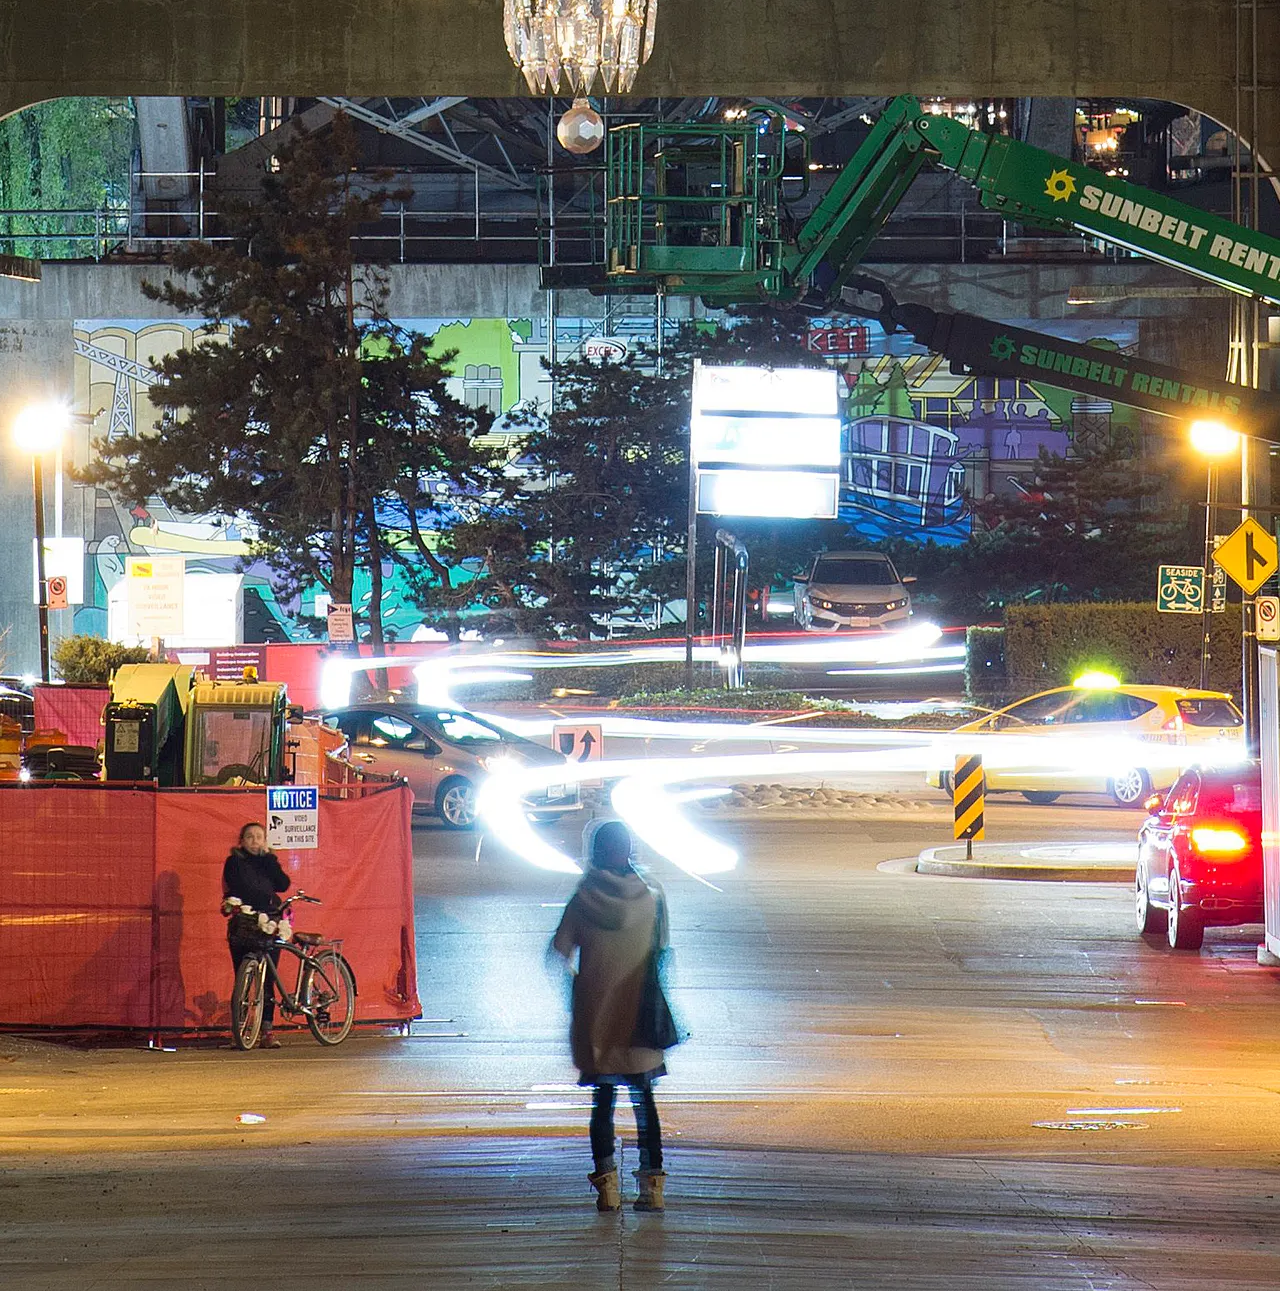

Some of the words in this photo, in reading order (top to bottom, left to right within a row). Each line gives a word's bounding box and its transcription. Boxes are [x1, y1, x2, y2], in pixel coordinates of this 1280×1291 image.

[1079, 185, 1208, 250] SUNBELT
[1019, 343, 1129, 388] SUNBELT
[1131, 372, 1242, 416] RENTALS
[1165, 568, 1199, 578] SEASIDE
[272, 790, 313, 809] NOTICE
[294, 814, 308, 822] VIDEO
[284, 824, 317, 833] SURVEILLANCE
[286, 835, 294, 843] ON
[294, 835, 305, 843] THIS
[305, 835, 315, 843] SITE
